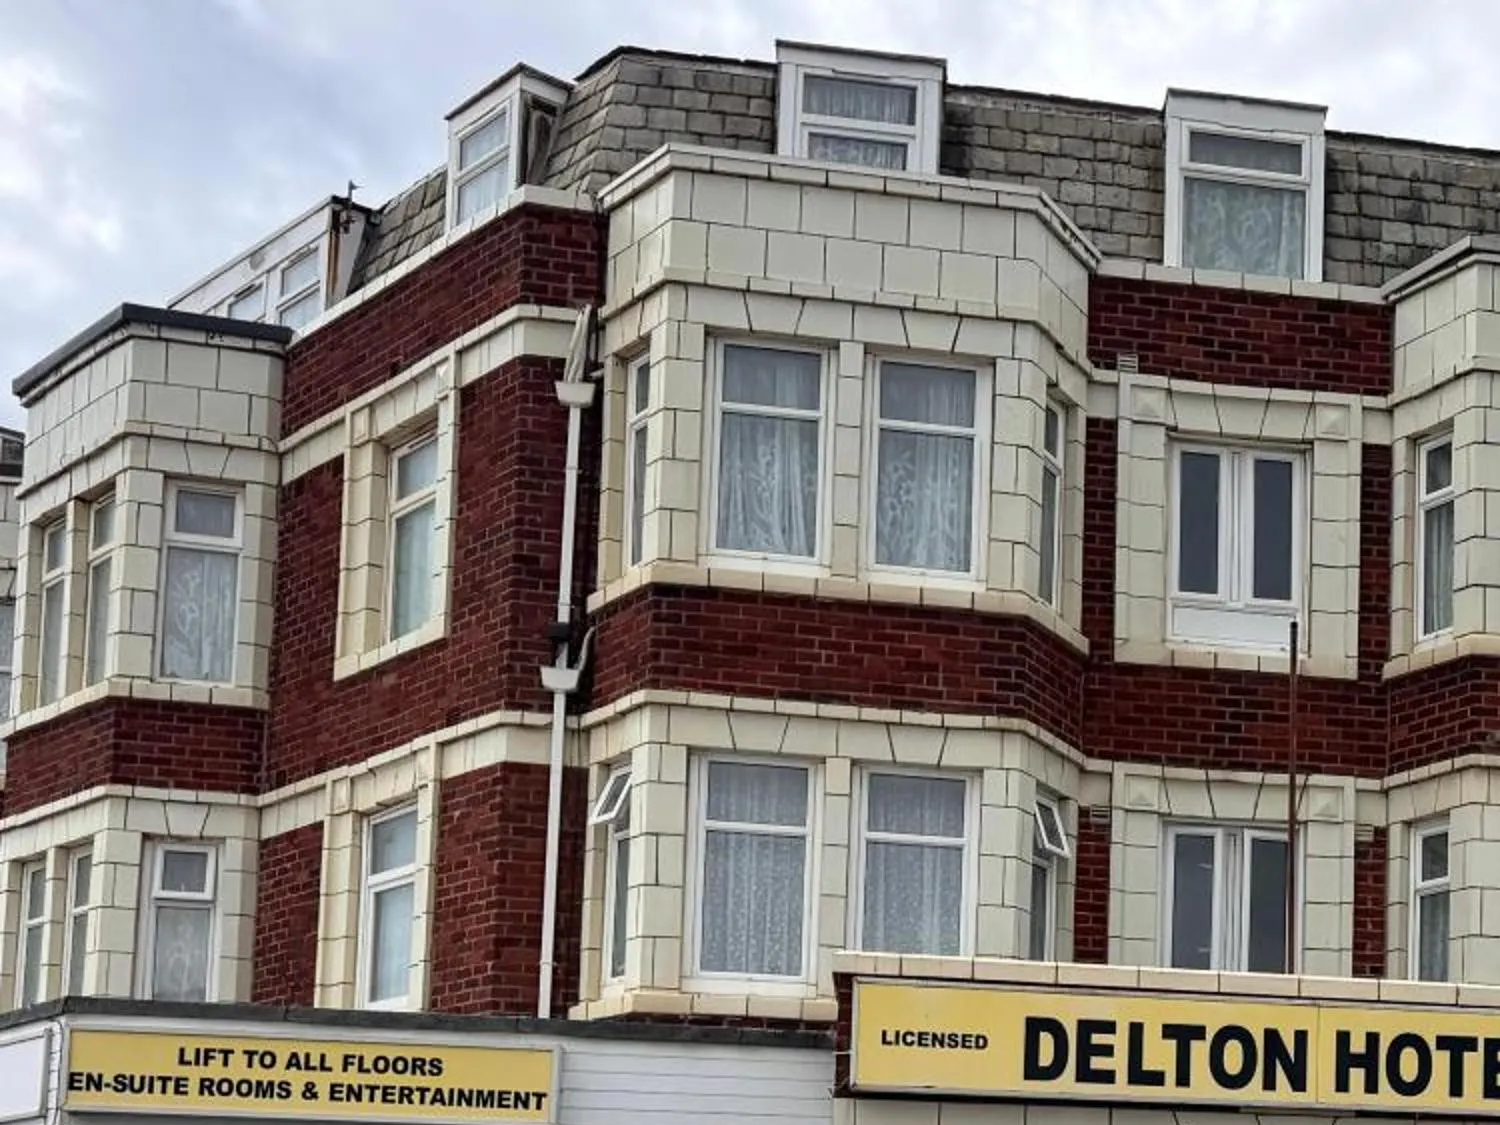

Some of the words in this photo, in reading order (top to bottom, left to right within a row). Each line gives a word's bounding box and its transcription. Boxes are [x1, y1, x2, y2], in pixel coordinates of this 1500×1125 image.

[881, 1028, 989, 1051] LICENSED
[1023, 1015, 1309, 1093] DELTON
[177, 1046, 235, 1068] LIFT
[243, 1049, 277, 1070] TO
[284, 1051, 333, 1073] ALL
[341, 1053, 444, 1077] FLOORS
[67, 1071, 190, 1096] EN-SUITE
[197, 1077, 292, 1100] ROOMS
[301, 1081, 319, 1101] &
[328, 1082, 548, 1111] ENTERTAINMENT
